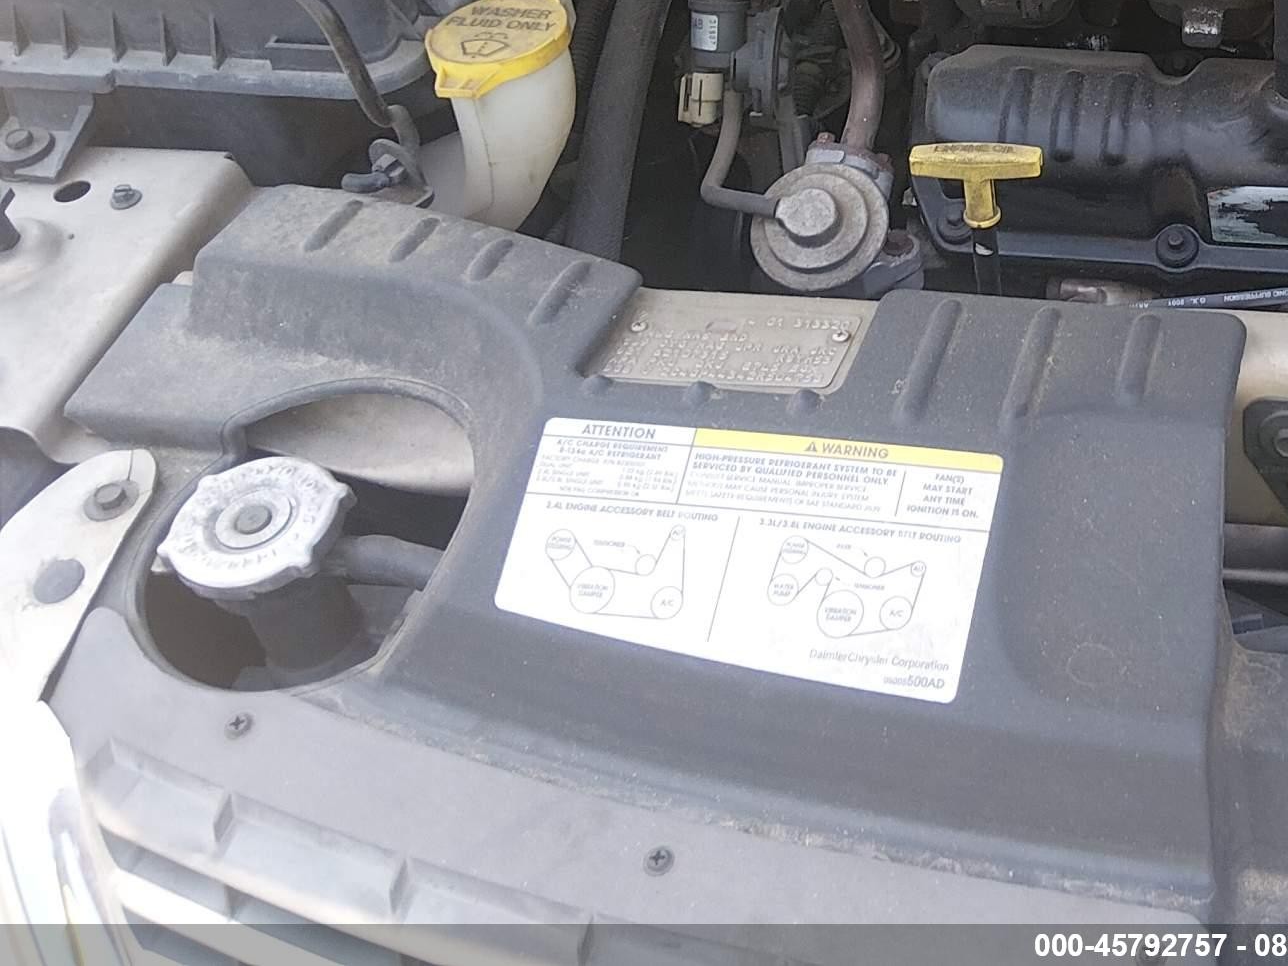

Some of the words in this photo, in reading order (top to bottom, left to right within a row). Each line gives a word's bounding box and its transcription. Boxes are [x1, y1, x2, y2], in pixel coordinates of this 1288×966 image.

[471, 6, 552, 20] WASHER
[447, 16, 501, 28] FLUID
[506, 19, 557, 32] ONLY
[581, 424, 656, 439] ATTENTION
[556, 437, 574, 446] A/C
[575, 439, 610, 449] CHARGE
[612, 442, 668, 453] REQUIREMENT
[822, 443, 889, 459] WARNING
[587, 448, 605, 456] A/C
[606, 450, 661, 460] REFRIGERANT
[691, 461, 737, 472] SERVICED
[740, 465, 751, 473] BY
[754, 466, 803, 478] QUALIFIED
[805, 471, 860, 482] PERSONNEL
[693, 452, 766, 465] HIGH-PRESSURE
[767, 458, 831, 471] REFRIGERANT
[833, 464, 869, 474] SYSTEM
[871, 468, 884, 476] TO
[885, 469, 897, 477] BE
[923, 483, 943, 492] MAY
[946, 485, 973, 495] START
[923, 495, 943, 504] ANY
[945, 497, 965, 506] TIME
[565, 502, 598, 513] ENGINE
[599, 505, 654, 516] ACCESSORY
[656, 509, 677, 519] BELT
[678, 512, 719, 522] ROUTING
[906, 504, 949, 516] IGNITION
[952, 508, 959, 516] IS
[962, 509, 979, 519] ON.
[803, 522, 837, 533] ENGINE
[839, 525, 895, 538] ACCESSORY
[898, 530, 917, 540] BELT
[919, 532, 962, 544] ROUTING
[660, 599, 674, 607] A/C
[889, 610, 903, 618] A/C
[809, 649, 888, 666] DaimlerChrysler
[891, 655, 949, 672] Corporation
